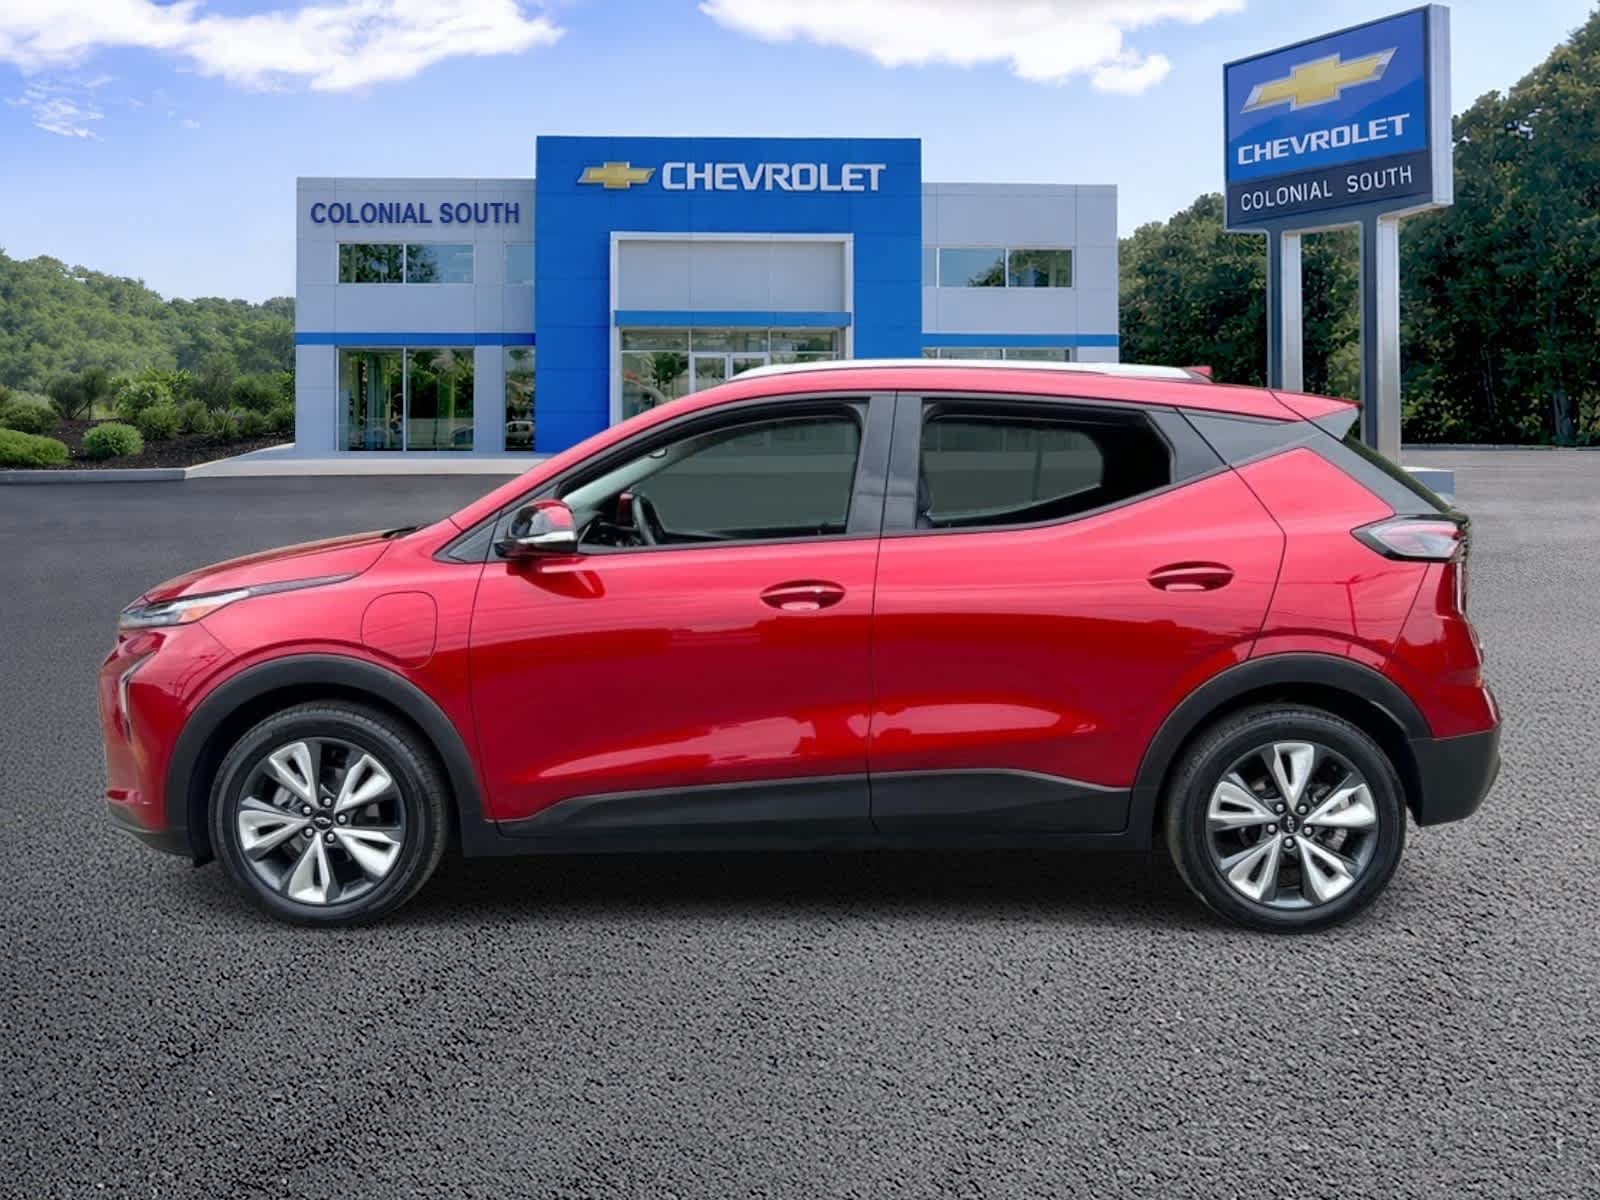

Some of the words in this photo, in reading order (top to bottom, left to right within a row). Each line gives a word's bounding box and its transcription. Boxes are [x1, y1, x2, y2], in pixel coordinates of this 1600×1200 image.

[1237, 113, 1410, 165] CHEVROLET
[662, 162, 886, 191] CHEVROLET
[1240, 179, 1333, 211] COLONIAL
[1346, 165, 1412, 193] SOUTH
[310, 202, 432, 224] COLONIAL
[439, 202, 520, 224] SOUTH
